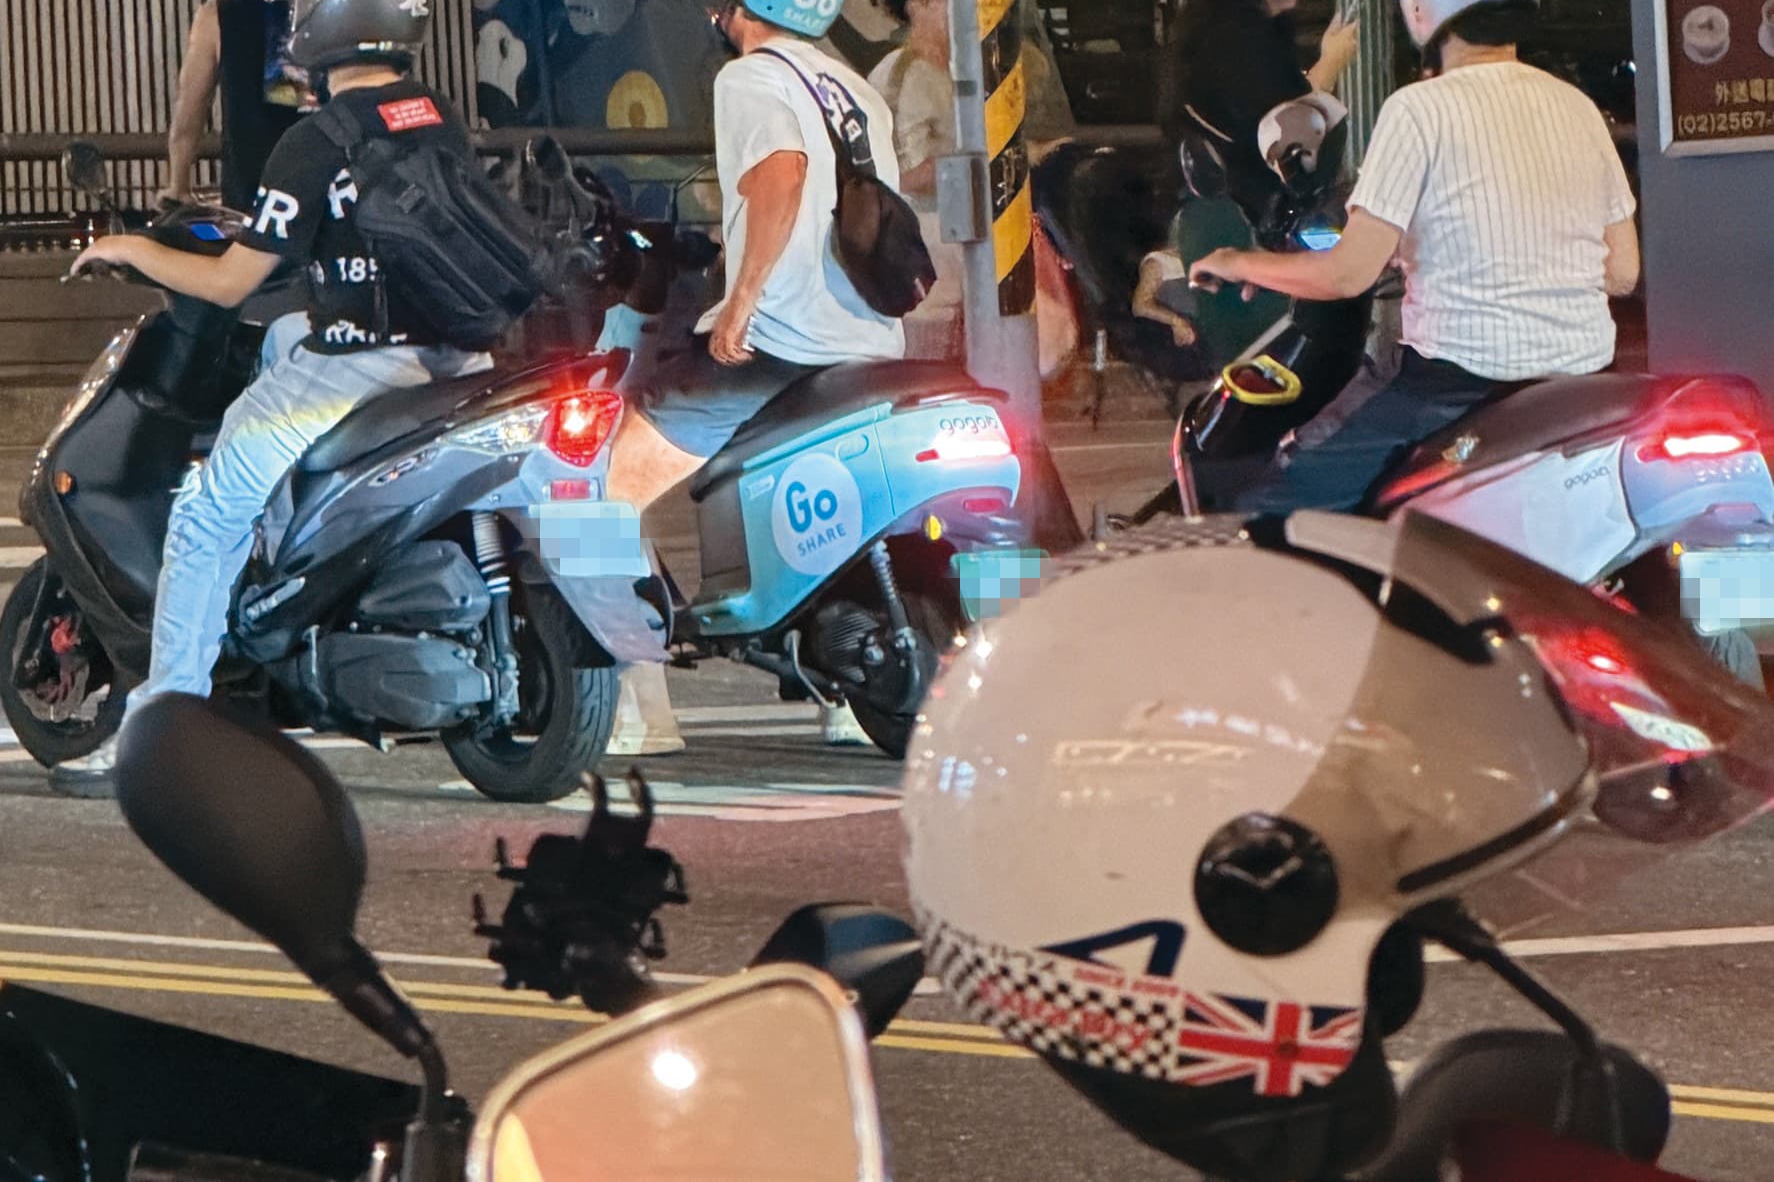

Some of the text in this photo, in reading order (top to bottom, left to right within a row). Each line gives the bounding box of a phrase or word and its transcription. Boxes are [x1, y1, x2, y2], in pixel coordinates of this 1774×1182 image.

[1678, 110, 1774, 137] (02)2567-
[785, 480, 839, 534] Go
[796, 522, 848, 558] SHARE
